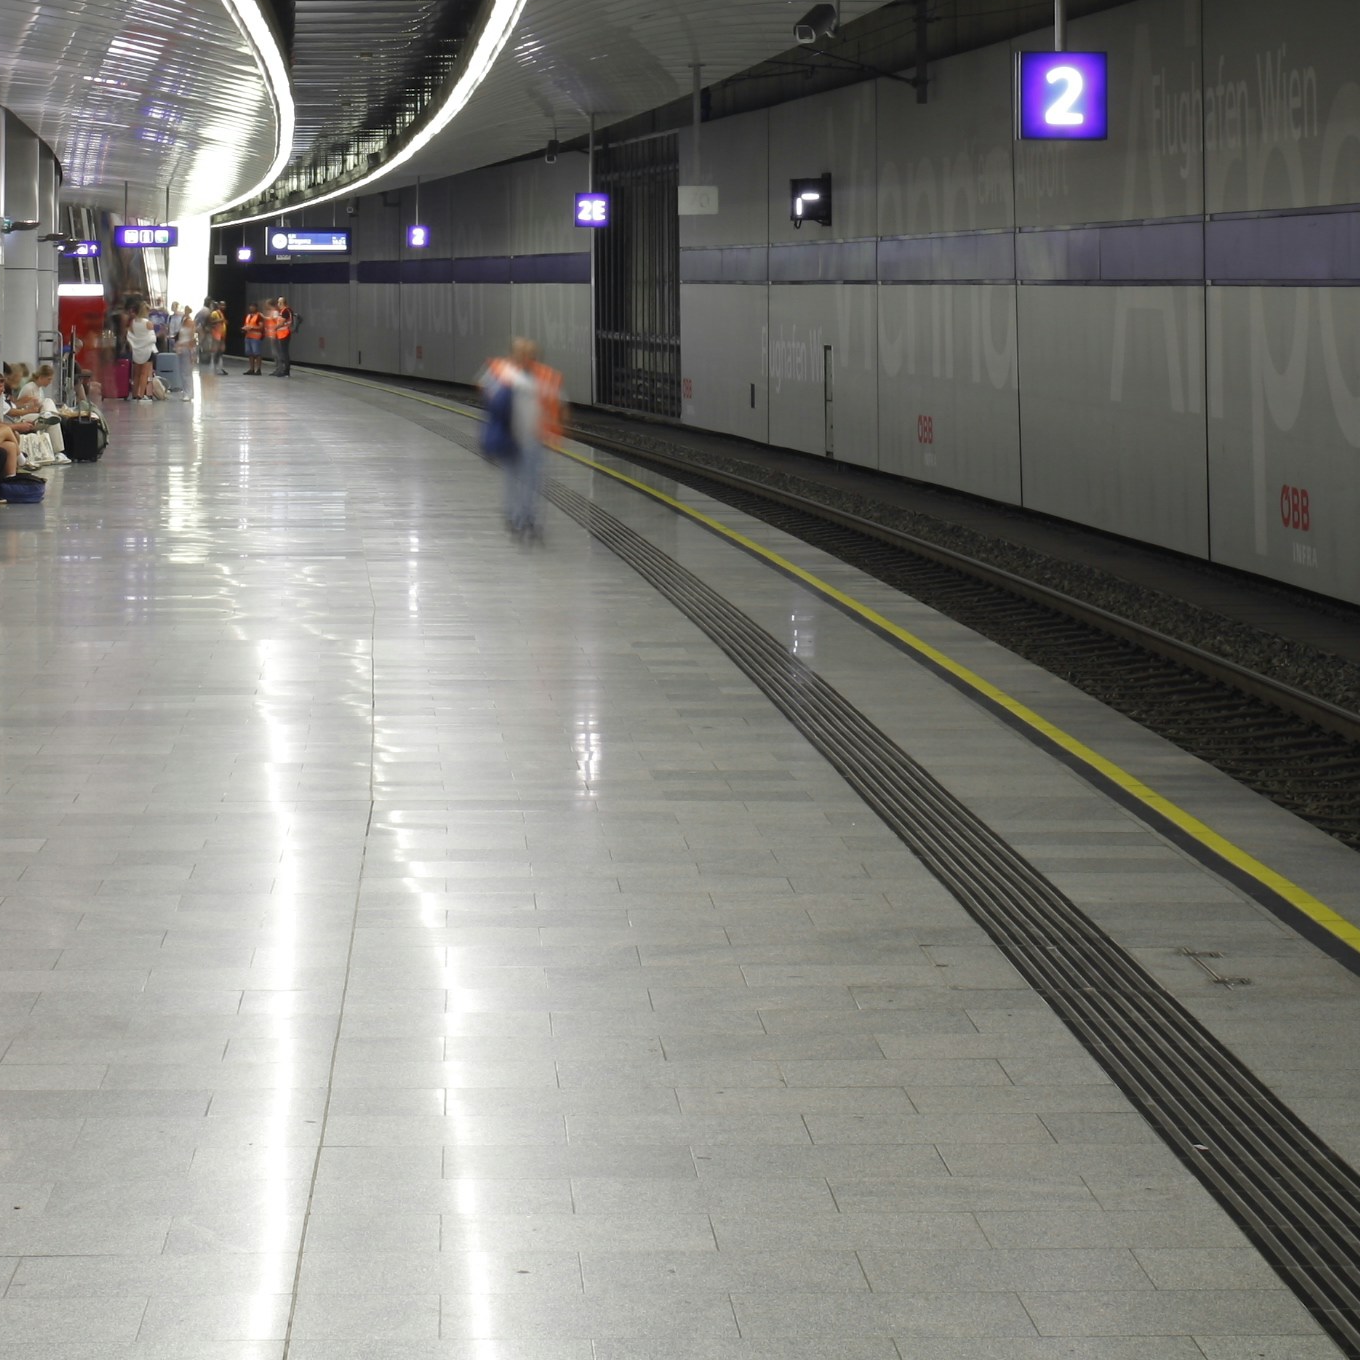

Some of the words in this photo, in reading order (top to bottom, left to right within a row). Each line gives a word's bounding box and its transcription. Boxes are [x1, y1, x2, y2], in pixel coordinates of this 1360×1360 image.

[1045, 66, 1084, 125] 2
[1256, 42, 1318, 143] Wien
[577, 200, 606, 221] 2E
[412, 228, 425, 246] 2
[1292, 542, 1319, 569] INFRA
